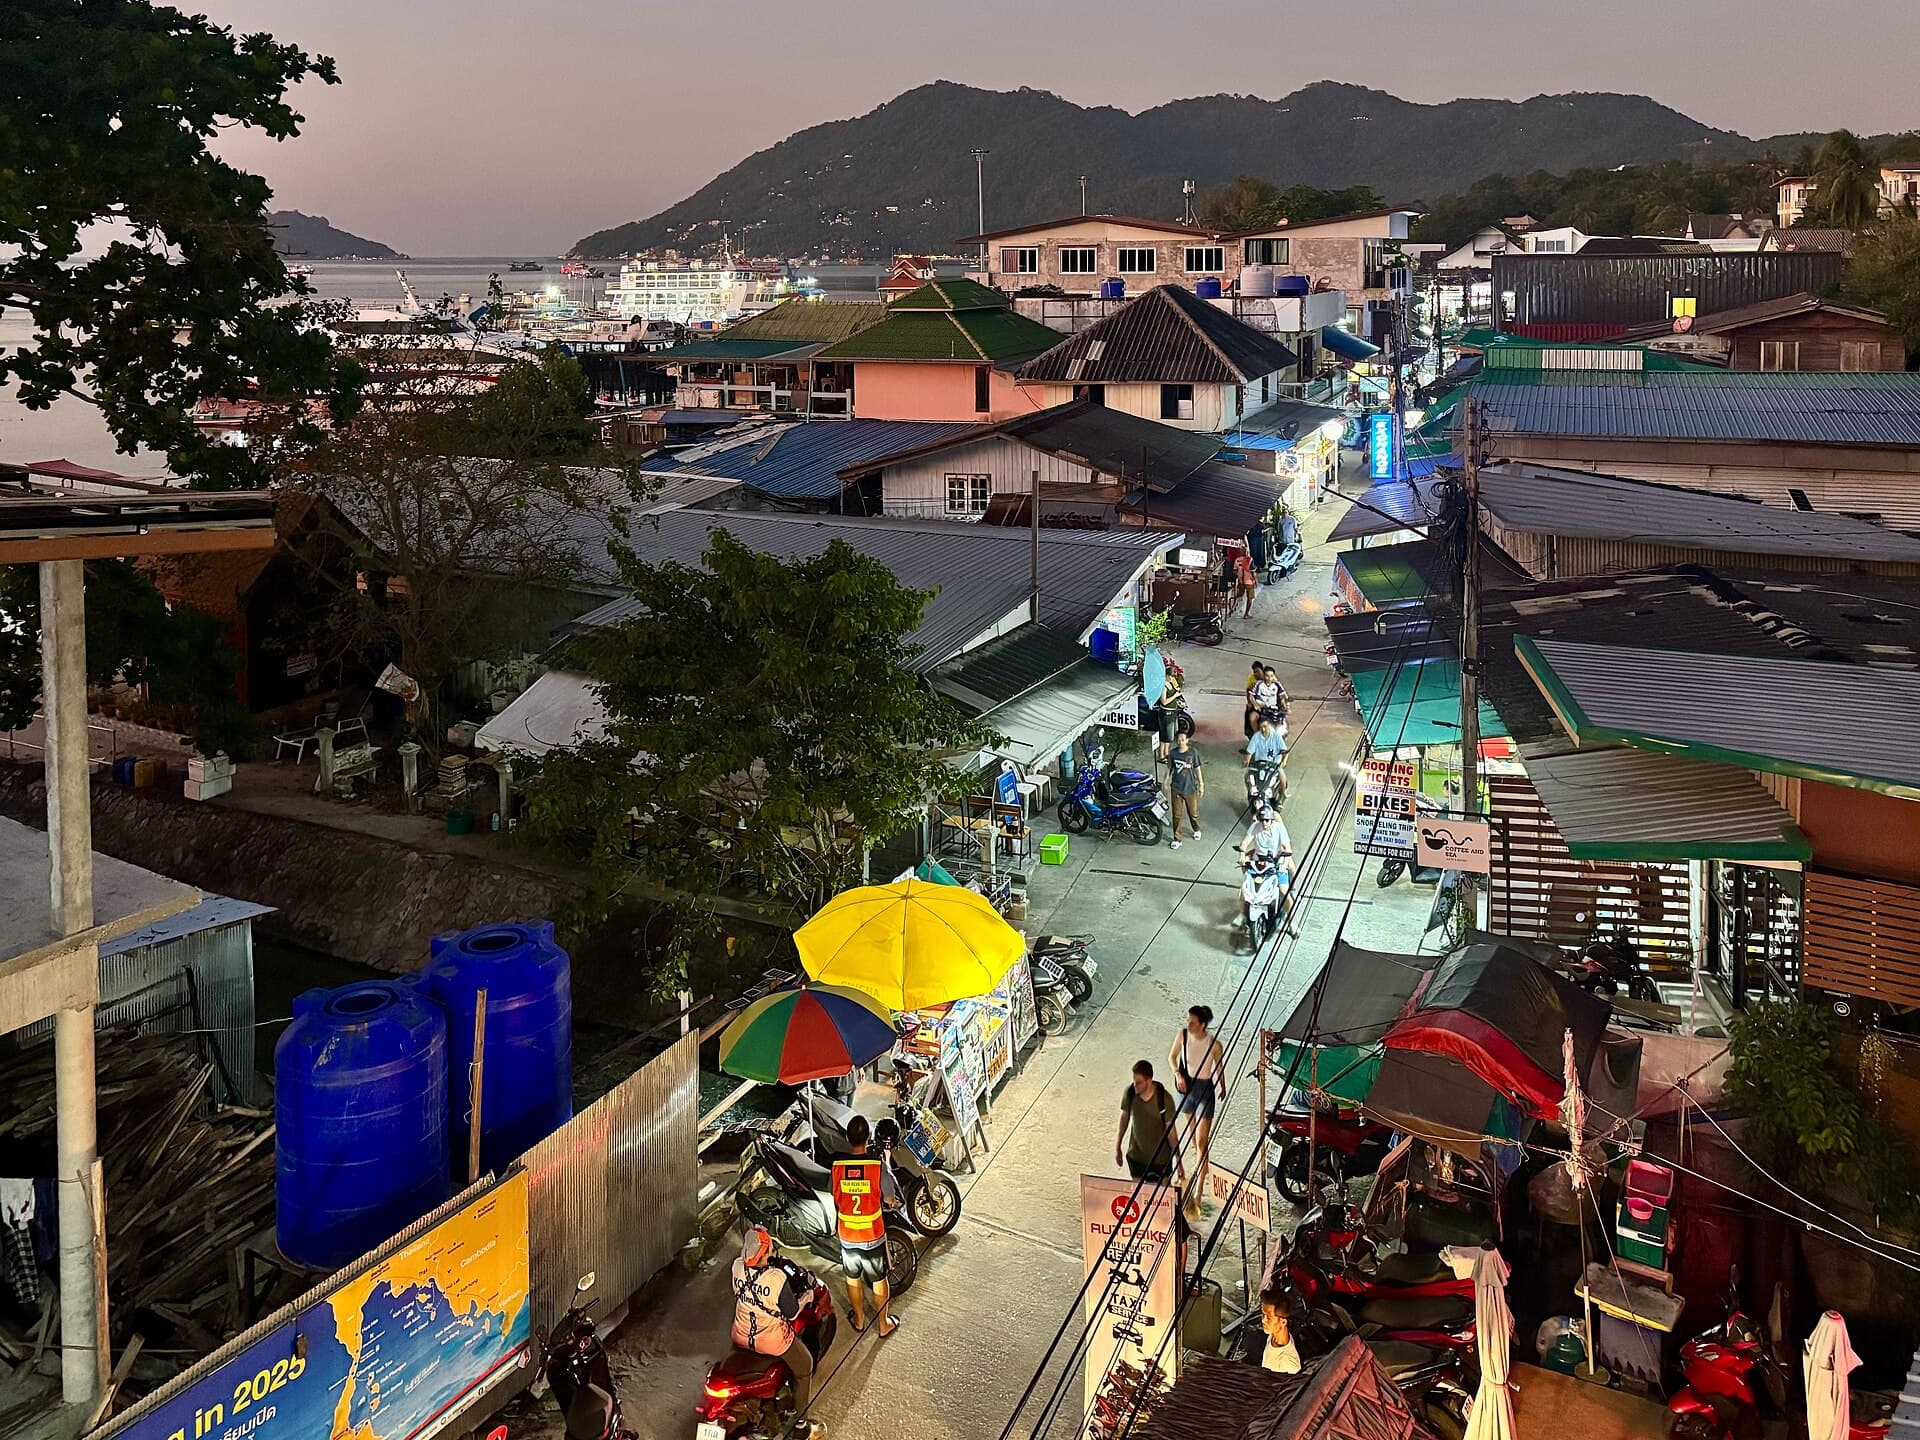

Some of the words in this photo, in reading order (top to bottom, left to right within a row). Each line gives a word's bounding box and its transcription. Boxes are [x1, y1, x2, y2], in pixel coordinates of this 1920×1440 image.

[1363, 794, 1410, 811] BIKES
[1356, 818, 1398, 831] SNORELING
[1399, 823, 1414, 832] TRIP
[1368, 828, 1388, 836] PVATE
[851, 1195, 862, 1215] 2
[1213, 1174, 1228, 1201] BIKE
[1245, 1190, 1264, 1221] RENT
[460, 1240, 496, 1268] Cambodia
[195, 1403, 223, 1437] in
[232, 1353, 307, 1416] 2025
